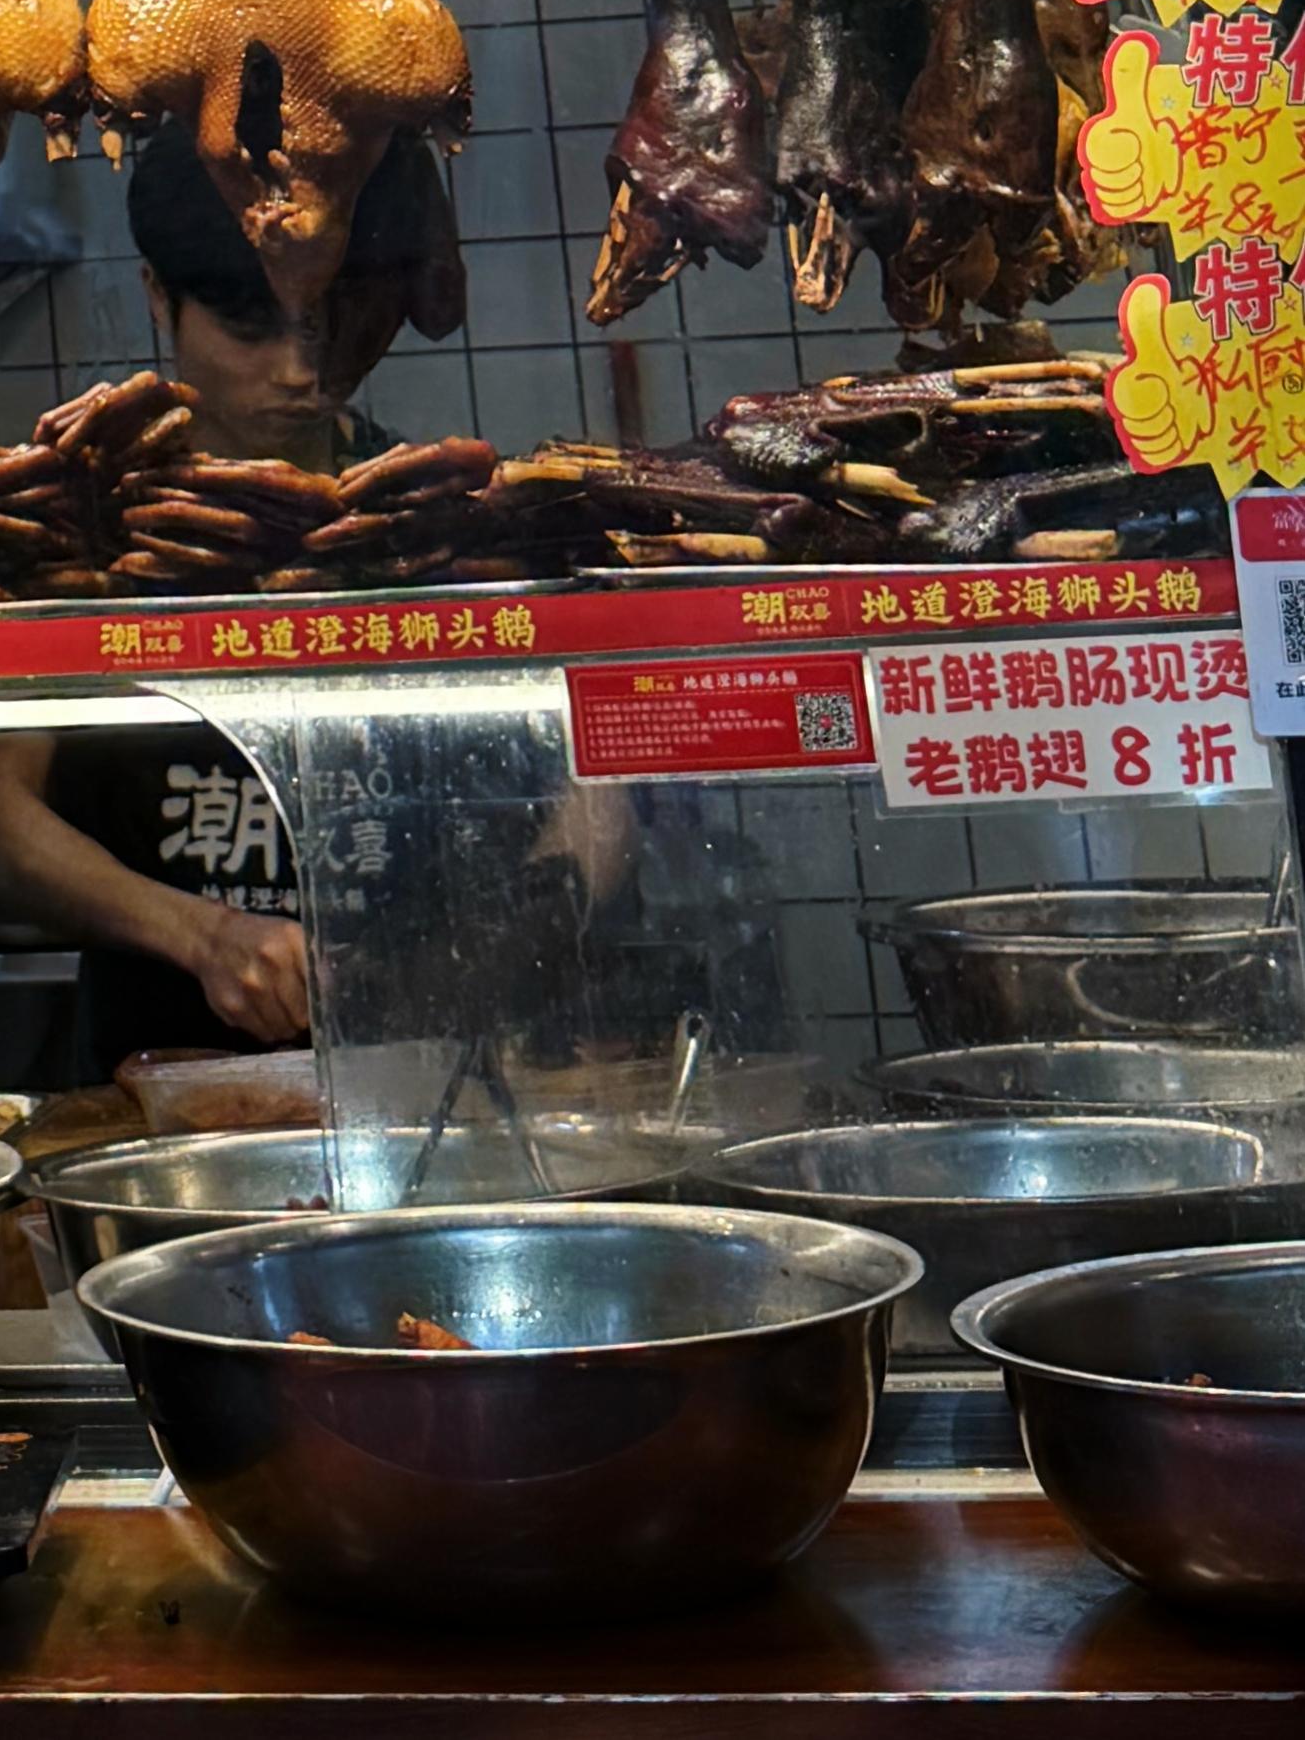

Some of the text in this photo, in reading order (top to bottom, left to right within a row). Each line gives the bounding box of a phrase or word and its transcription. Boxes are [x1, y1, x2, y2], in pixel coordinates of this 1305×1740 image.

[1194, 236, 1305, 342] 特
[212, 604, 536, 659] 地道澄海狮头鹅
[860, 566, 1202, 624] 地道澄海狮头鹅
[879, 639, 1249, 716] 新鲜鹅肠现烫
[905, 723, 1236, 796] 老鹅翅 8 折
[159, 764, 279, 880] 潮
